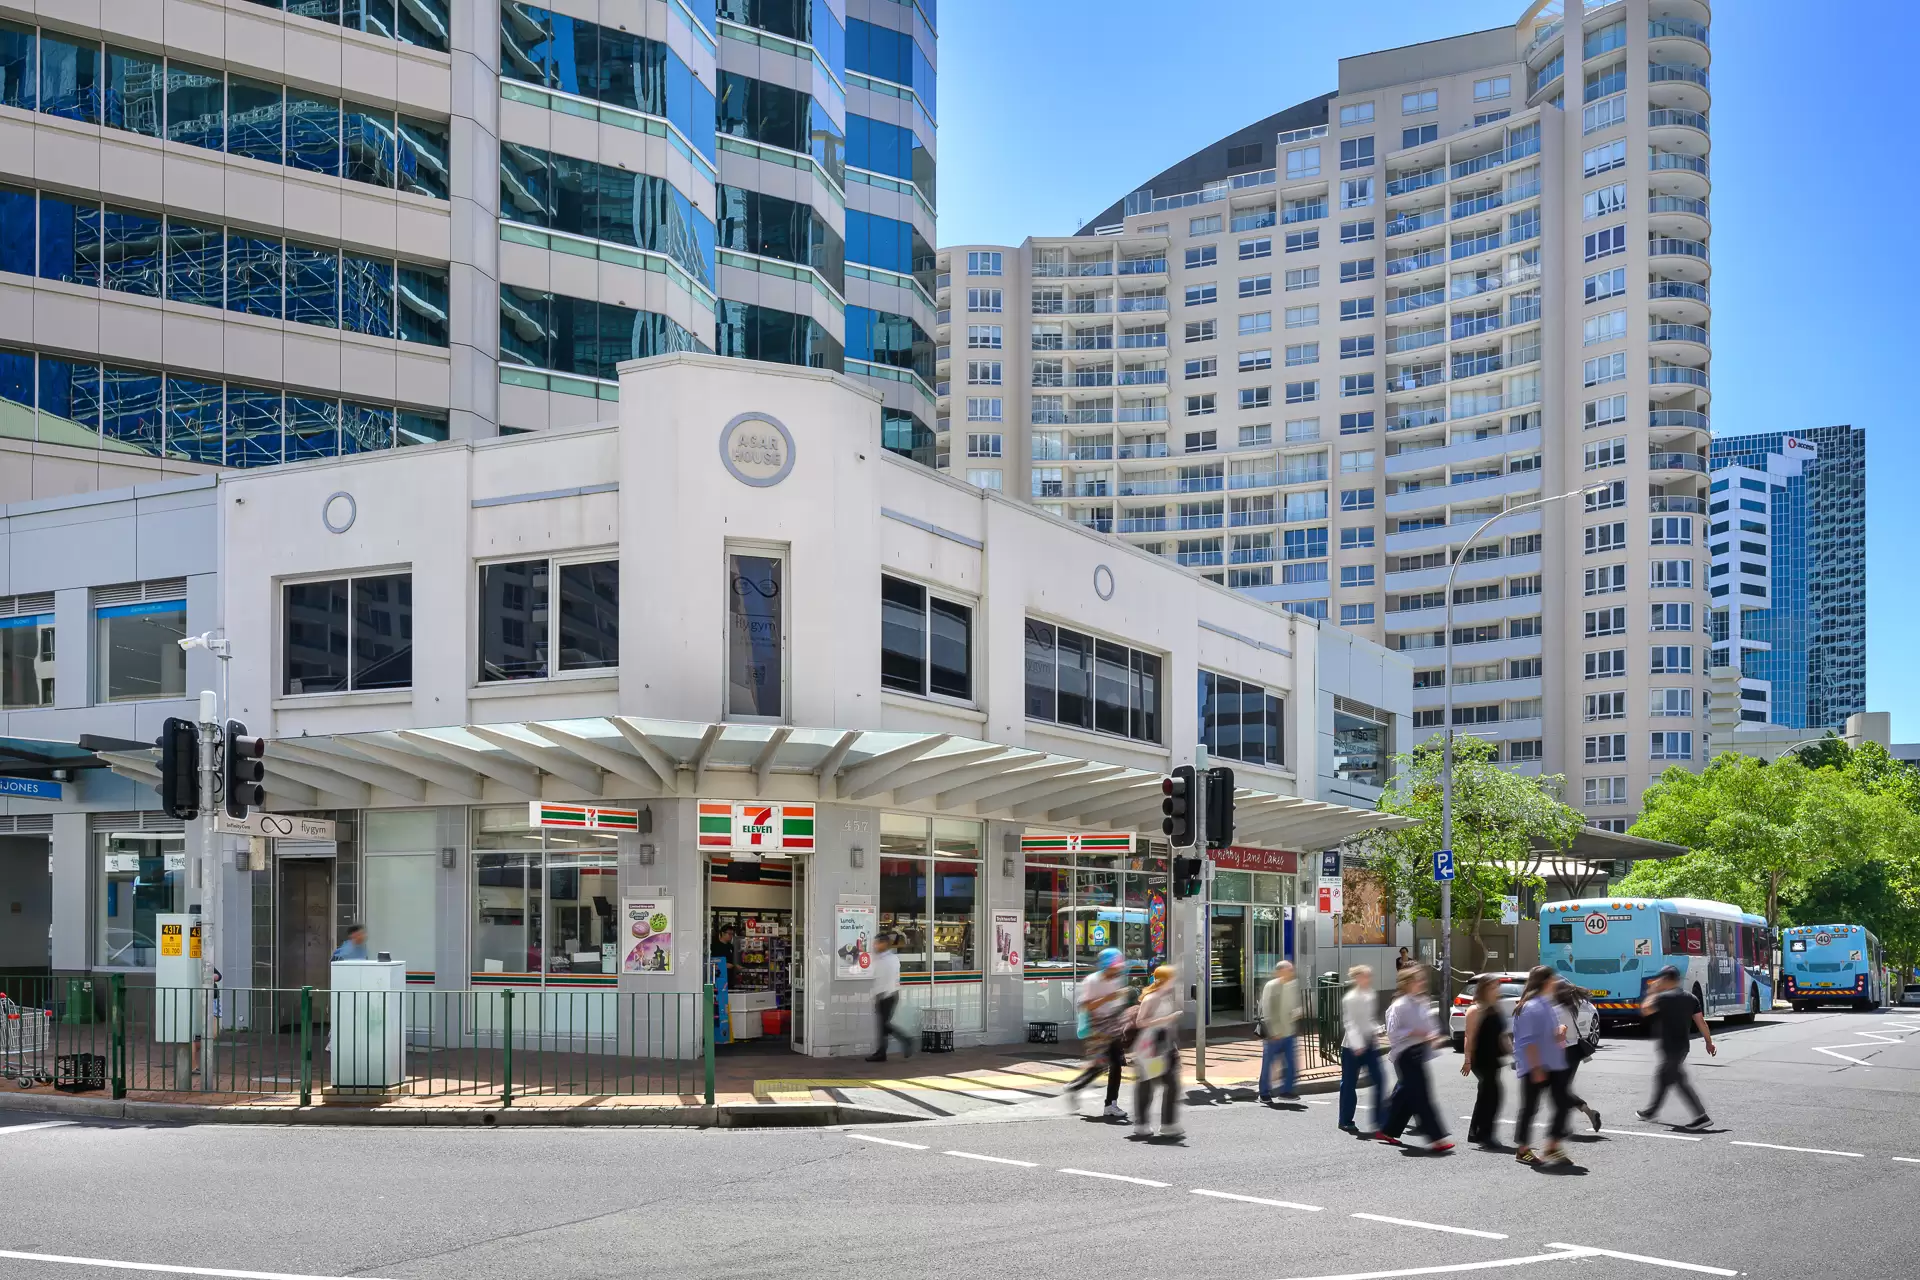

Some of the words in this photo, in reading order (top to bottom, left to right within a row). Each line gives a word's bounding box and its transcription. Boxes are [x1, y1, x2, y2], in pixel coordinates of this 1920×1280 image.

[737, 434, 779, 451] AGAR
[1797, 442, 1815, 451] access
[732, 447, 781, 467] HOUSE
[844, 818, 869, 833] 457
[1243, 851, 1261, 864] Lane
[1263, 852, 1285, 866] Cakes
[1437, 853, 1449, 869] P
[163, 925, 180, 934] 4317
[1588, 918, 1604, 930] 40
[1818, 935, 1829, 943] 40
